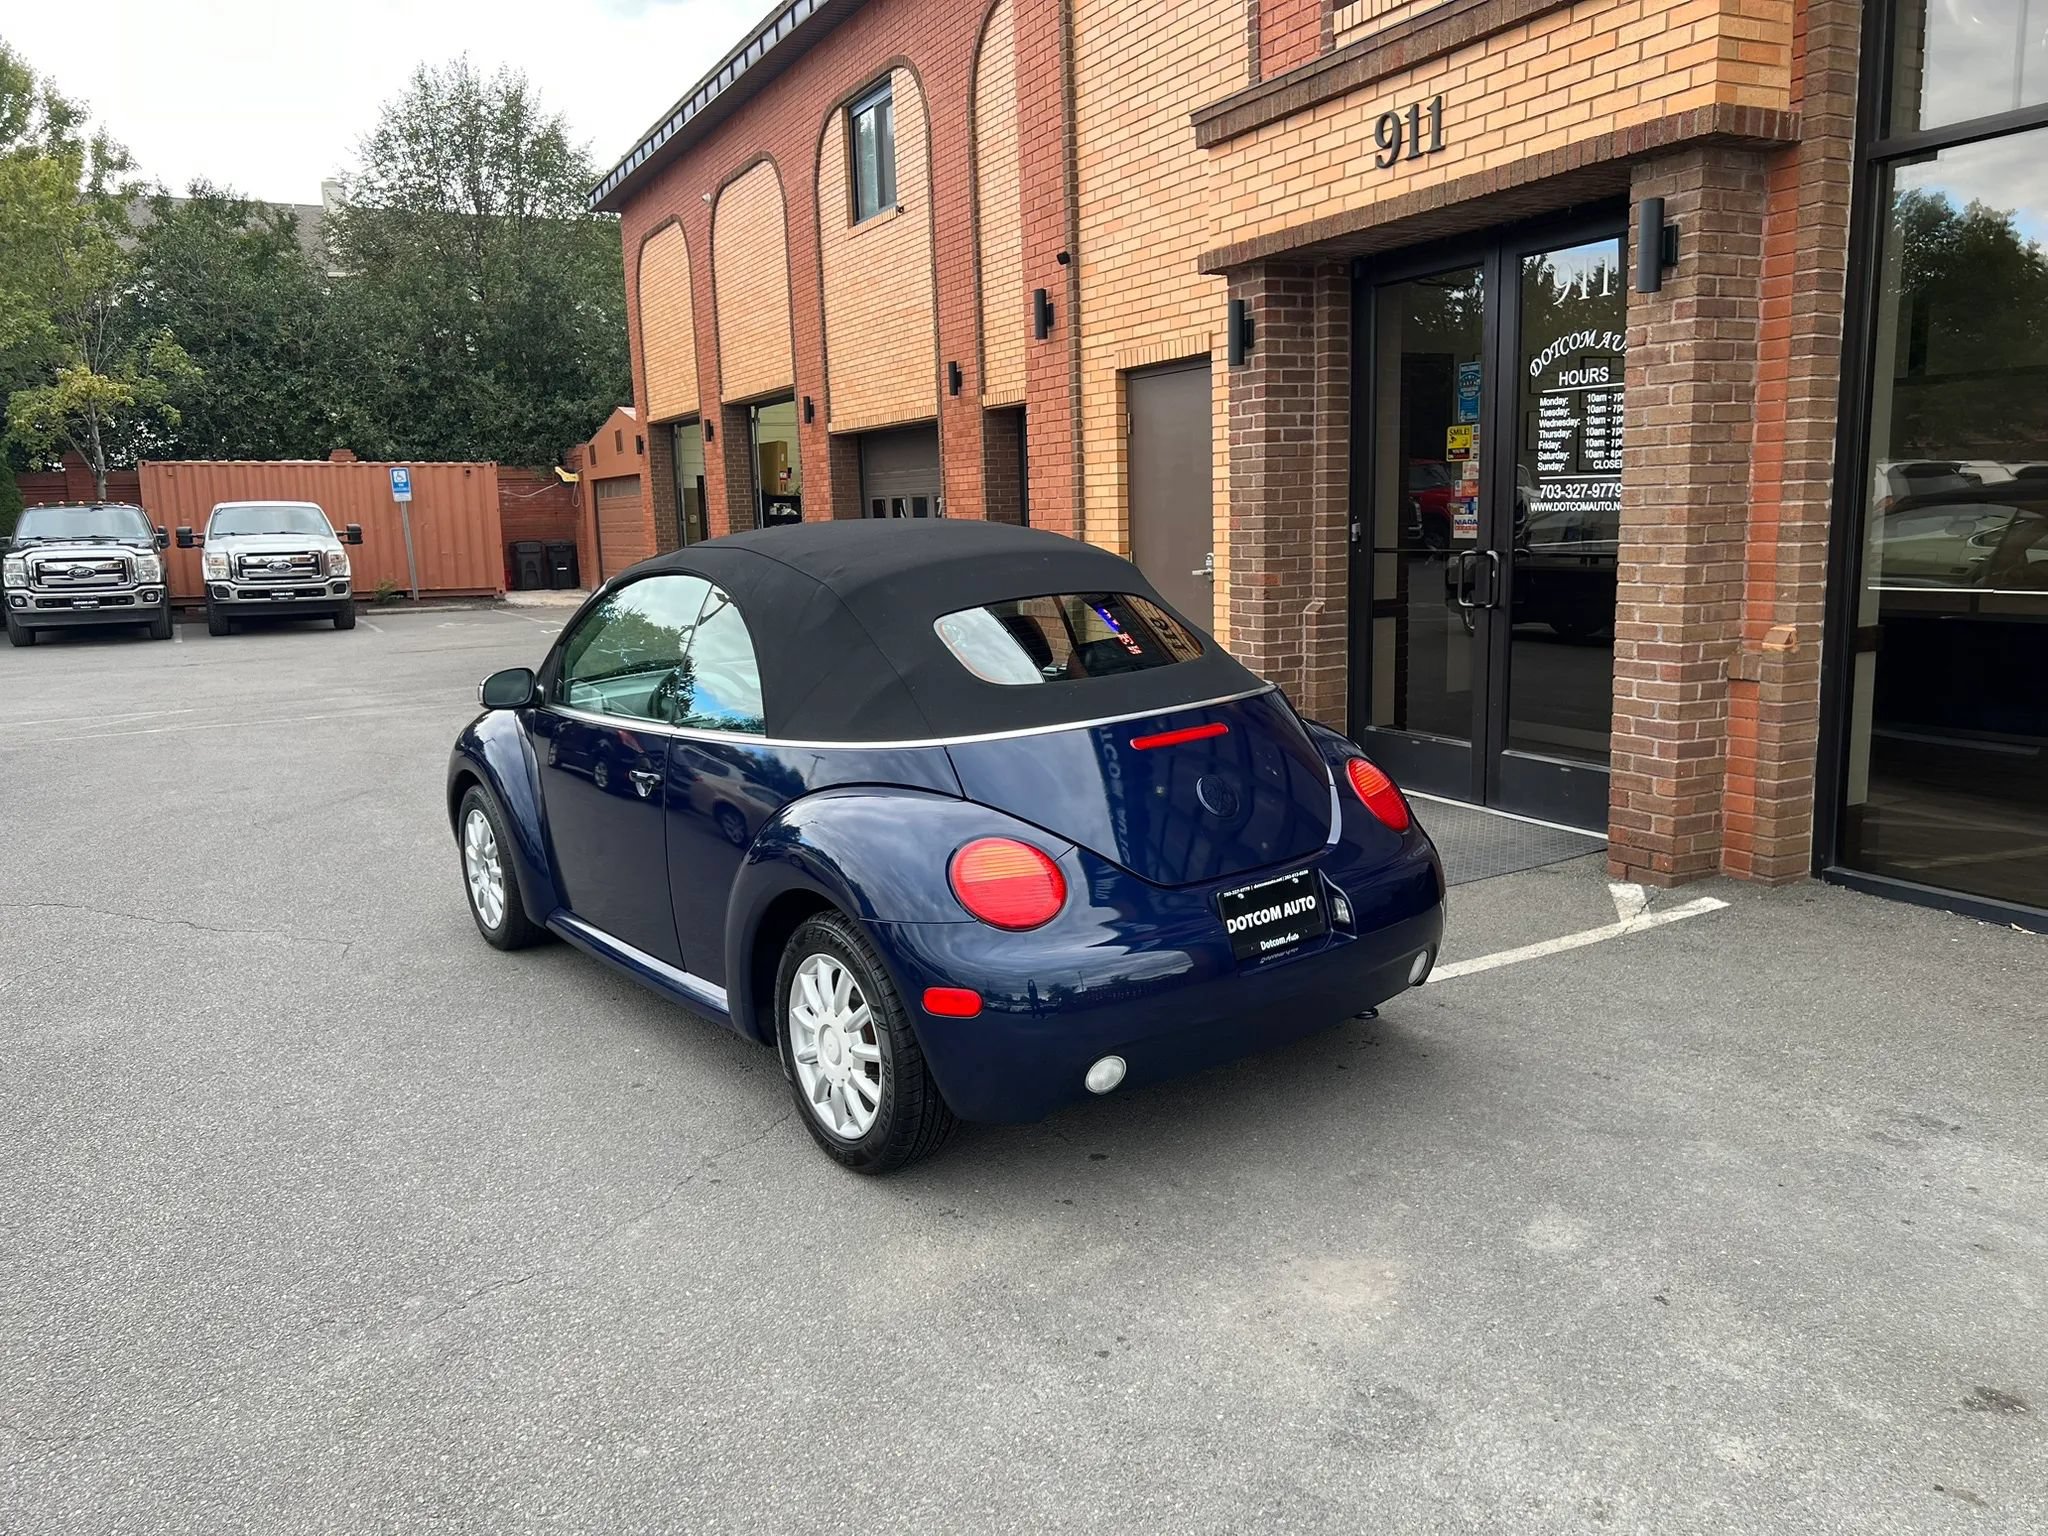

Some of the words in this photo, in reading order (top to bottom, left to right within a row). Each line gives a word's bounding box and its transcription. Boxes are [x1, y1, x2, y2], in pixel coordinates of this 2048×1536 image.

[1375, 95, 1446, 169] 911
[1553, 256, 1613, 305] 911
[1529, 329, 1597, 377] DOTCOM
[1595, 331, 1626, 353] AU
[1559, 366, 1609, 386] HOURS
[1540, 397, 1568, 407] Monday:
[1587, 394, 1607, 403] 10am
[1539, 408, 1570, 417] Tuesday:
[1586, 405, 1606, 414] 10am
[1539, 418, 1580, 428] Wednesday:
[1586, 416, 1606, 425] 10am
[1538, 430, 1572, 439] Thursday:
[1585, 427, 1605, 436] 10am
[1538, 441, 1561, 450] Friday:
[1585, 438, 1605, 448] 10am
[1537, 452, 1570, 461] Saturday:
[1584, 449, 1604, 459] 10am
[1537, 462, 1565, 472] Sunday:
[1540, 483, 1623, 499] 703-327-9779
[1530, 501, 1621, 512] WWW.DOTCOMAUTO.N
[1226, 905, 1282, 934] DOTCOM
[1284, 895, 1316, 917] AUTO
[1260, 936, 1286, 951] Dotcom
[1285, 932, 1300, 944] Auto
